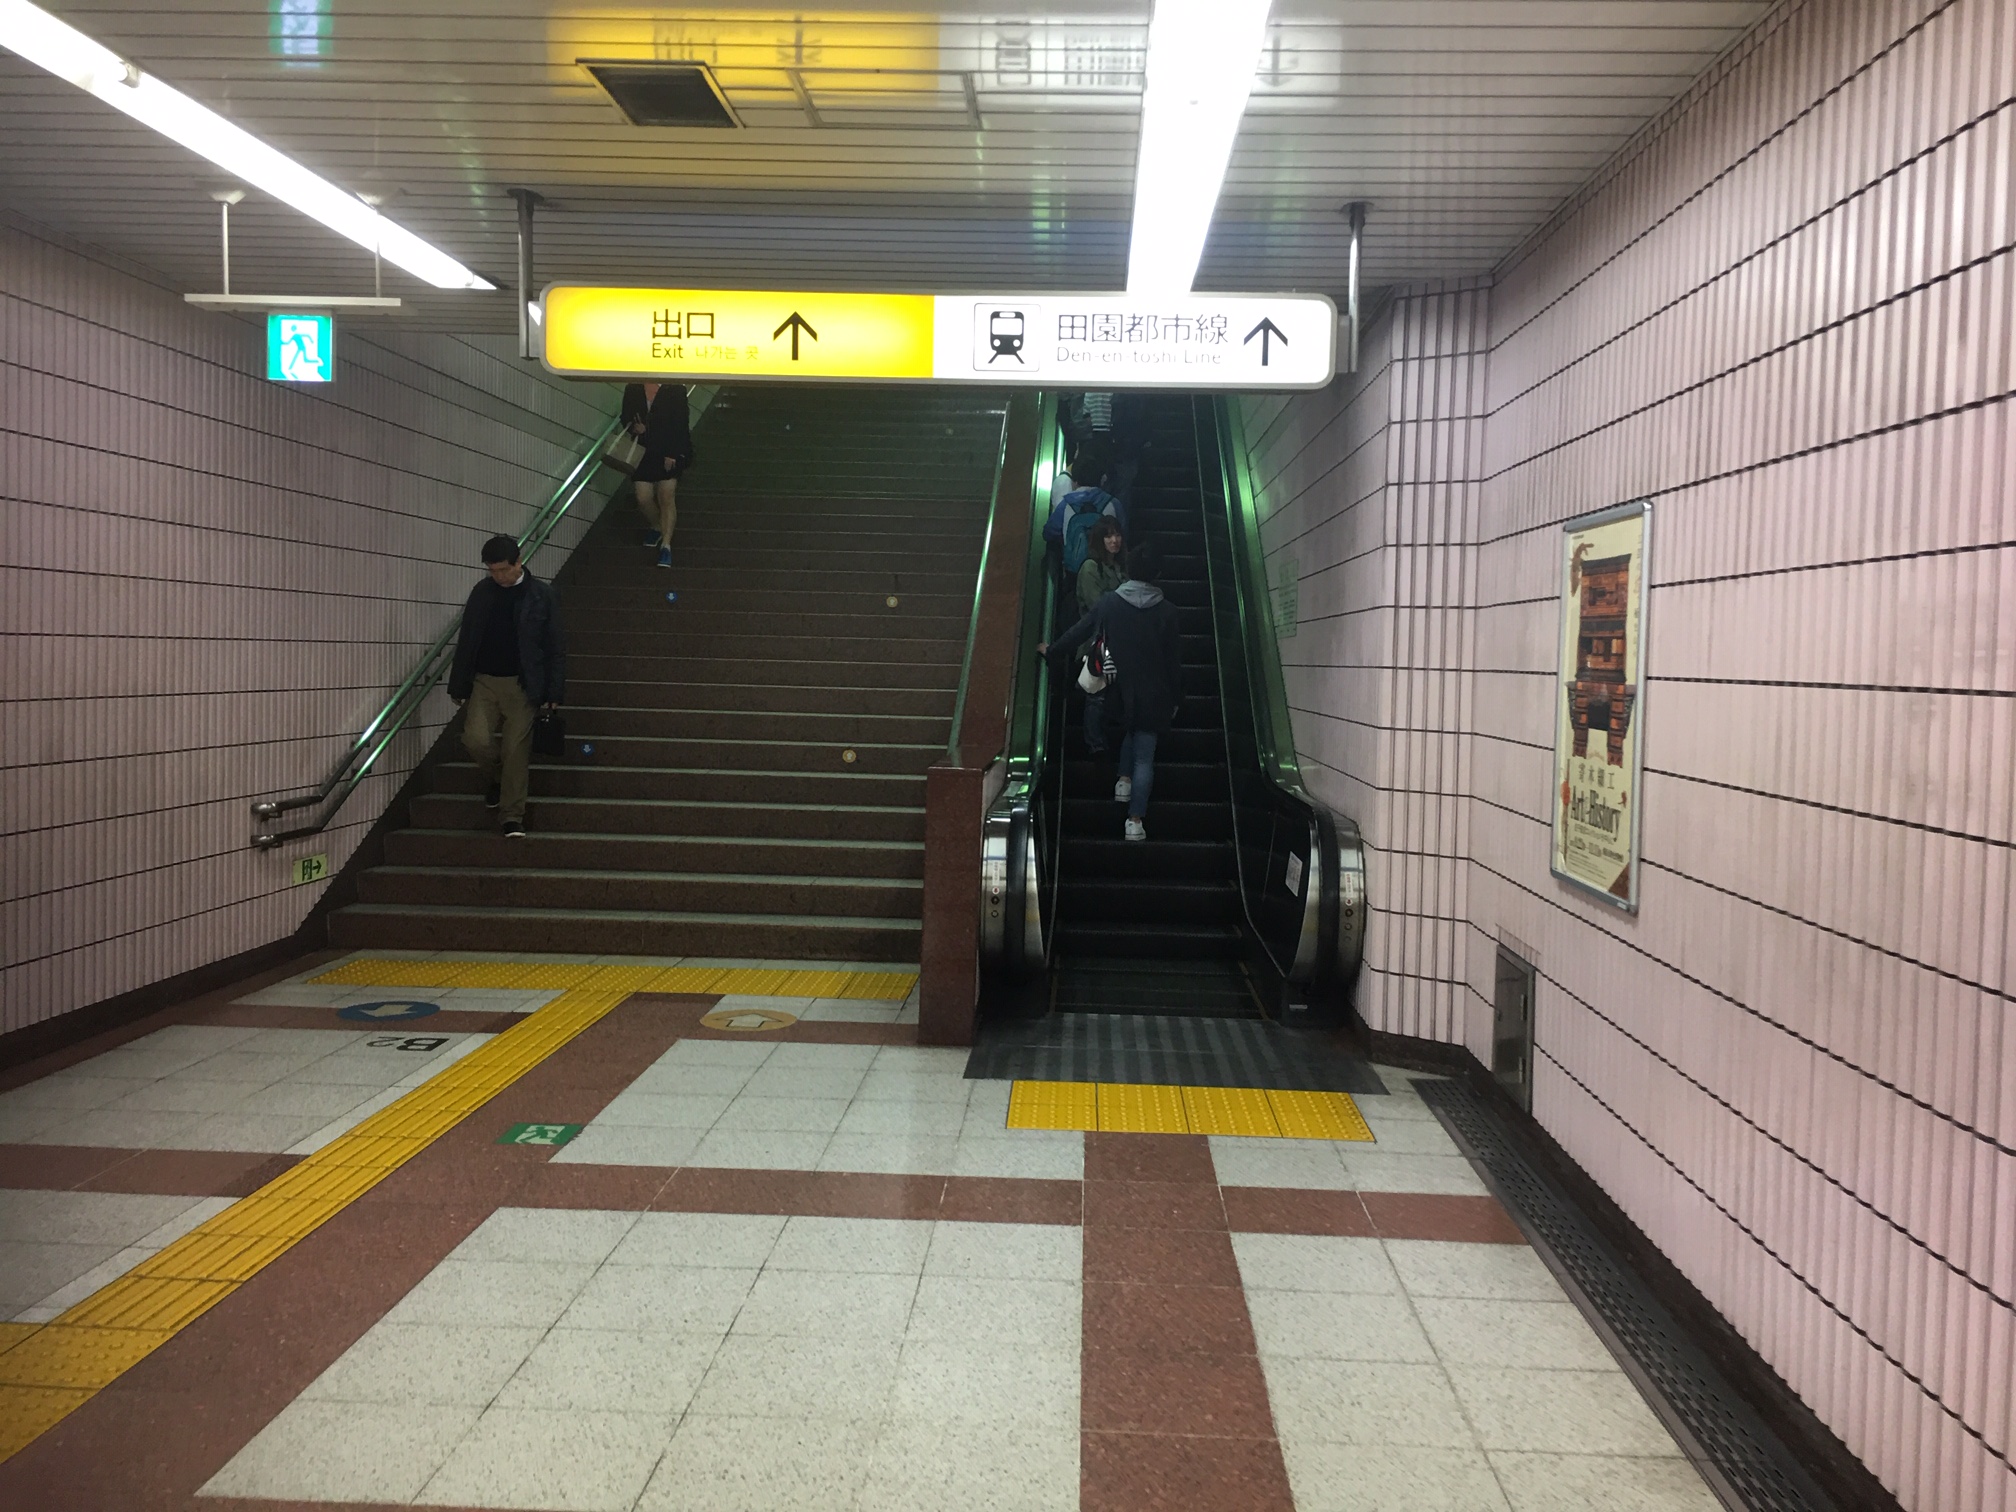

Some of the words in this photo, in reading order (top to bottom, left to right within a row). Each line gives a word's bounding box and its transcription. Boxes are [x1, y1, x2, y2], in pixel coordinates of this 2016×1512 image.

[652, 309, 715, 339] 出口
[1058, 313, 1228, 344] 田園都市線
[652, 342, 684, 359] Exit
[695, 346, 737, 360] 나가는
[747, 347, 759, 360] 곳
[1057, 347, 1176, 363] Den-en-toshi
[1184, 349, 1222, 366] Line
[366, 1036, 450, 1052] B2
